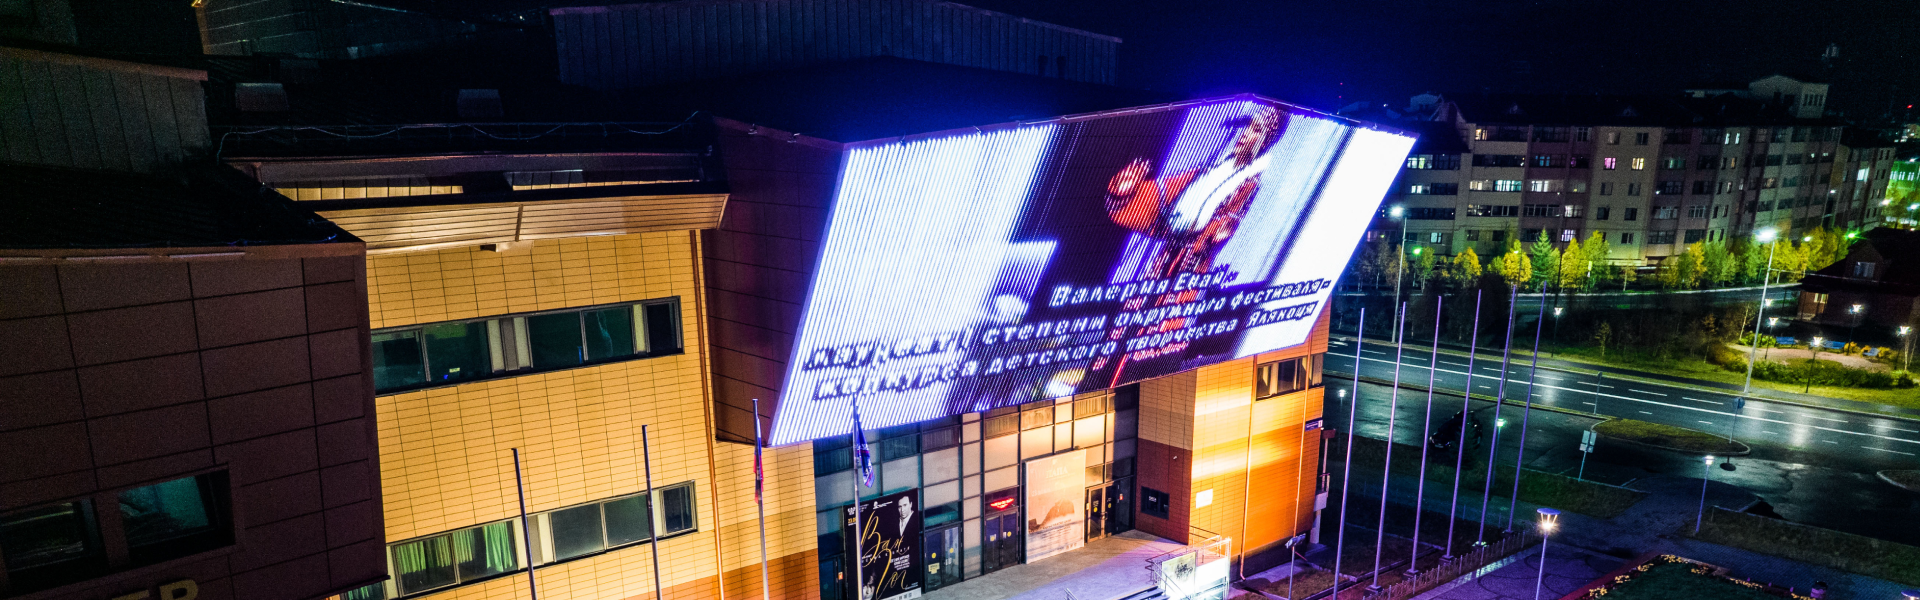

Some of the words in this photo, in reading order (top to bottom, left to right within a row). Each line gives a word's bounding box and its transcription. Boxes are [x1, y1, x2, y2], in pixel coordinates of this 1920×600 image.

[1049, 279, 1169, 308] Валерия
[982, 313, 1107, 345] степени
[1113, 296, 1227, 327] окружного
[985, 341, 1118, 376] детского
[1126, 317, 1239, 349] творчества
